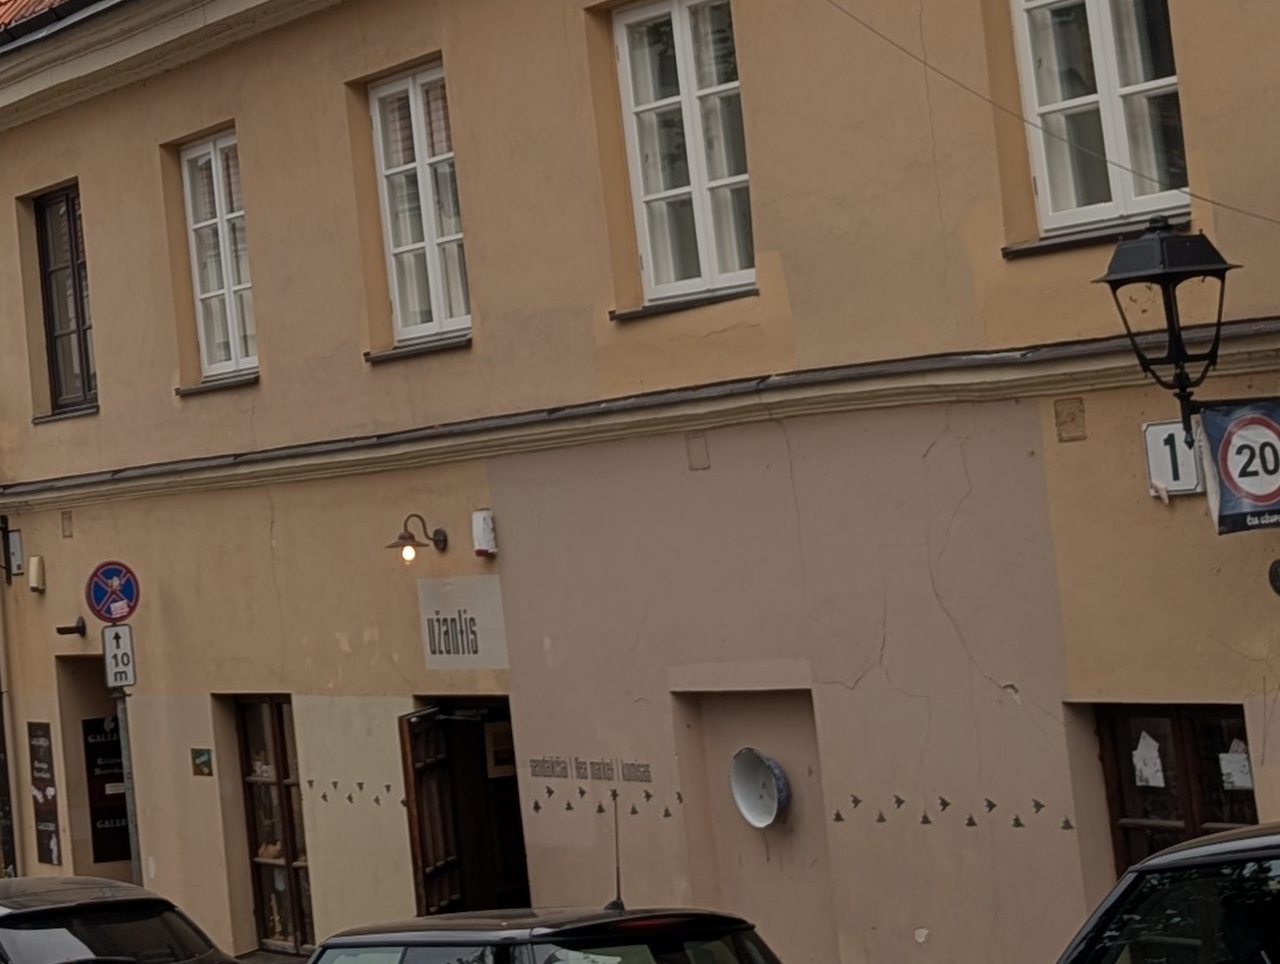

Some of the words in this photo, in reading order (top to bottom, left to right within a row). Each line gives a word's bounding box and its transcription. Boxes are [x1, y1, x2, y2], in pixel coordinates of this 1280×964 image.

[1163, 432, 1180, 482] 1
[1235, 441, 1280, 478] 20
[111, 652, 131, 668] 10
[114, 670, 128, 683] m
